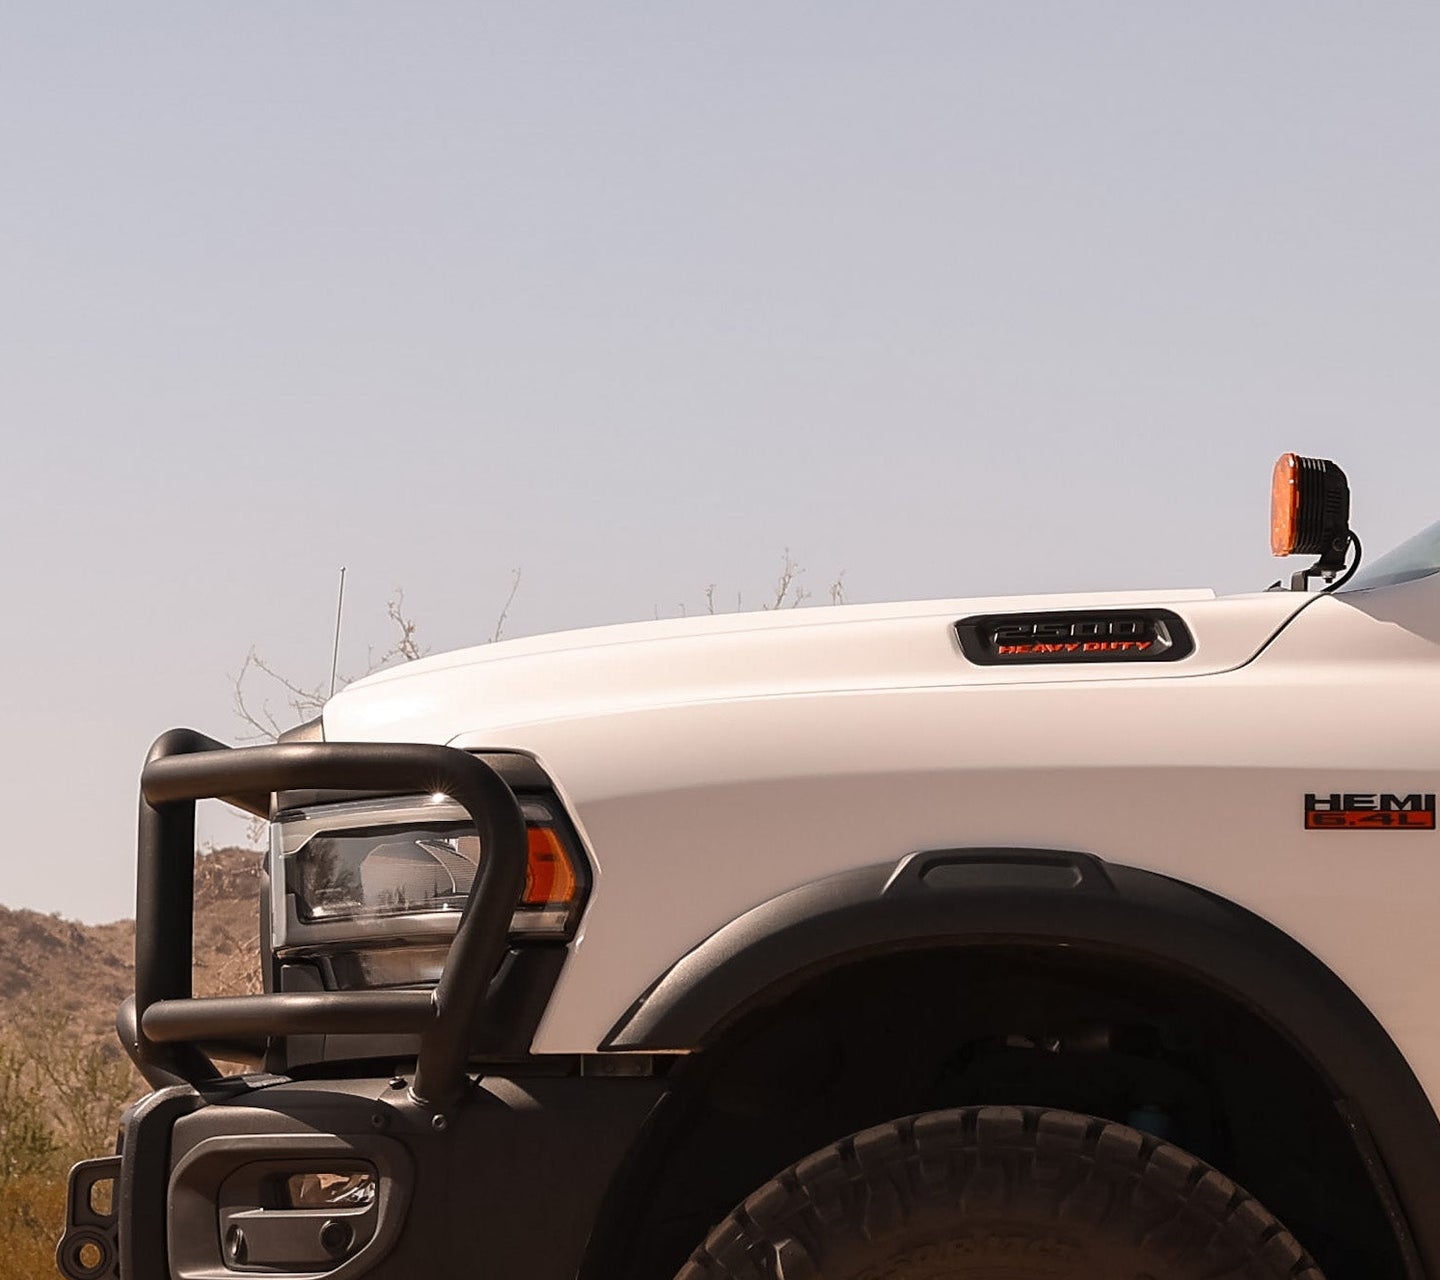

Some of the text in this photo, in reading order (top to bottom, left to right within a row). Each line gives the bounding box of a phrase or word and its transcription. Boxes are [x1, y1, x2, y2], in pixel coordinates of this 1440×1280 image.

[992, 621, 1143, 644] 2500
[998, 640, 1153, 655] HEAVY DUTY
[1304, 793, 1437, 811] HEMI
[1312, 812, 1426, 826] 6.4L
